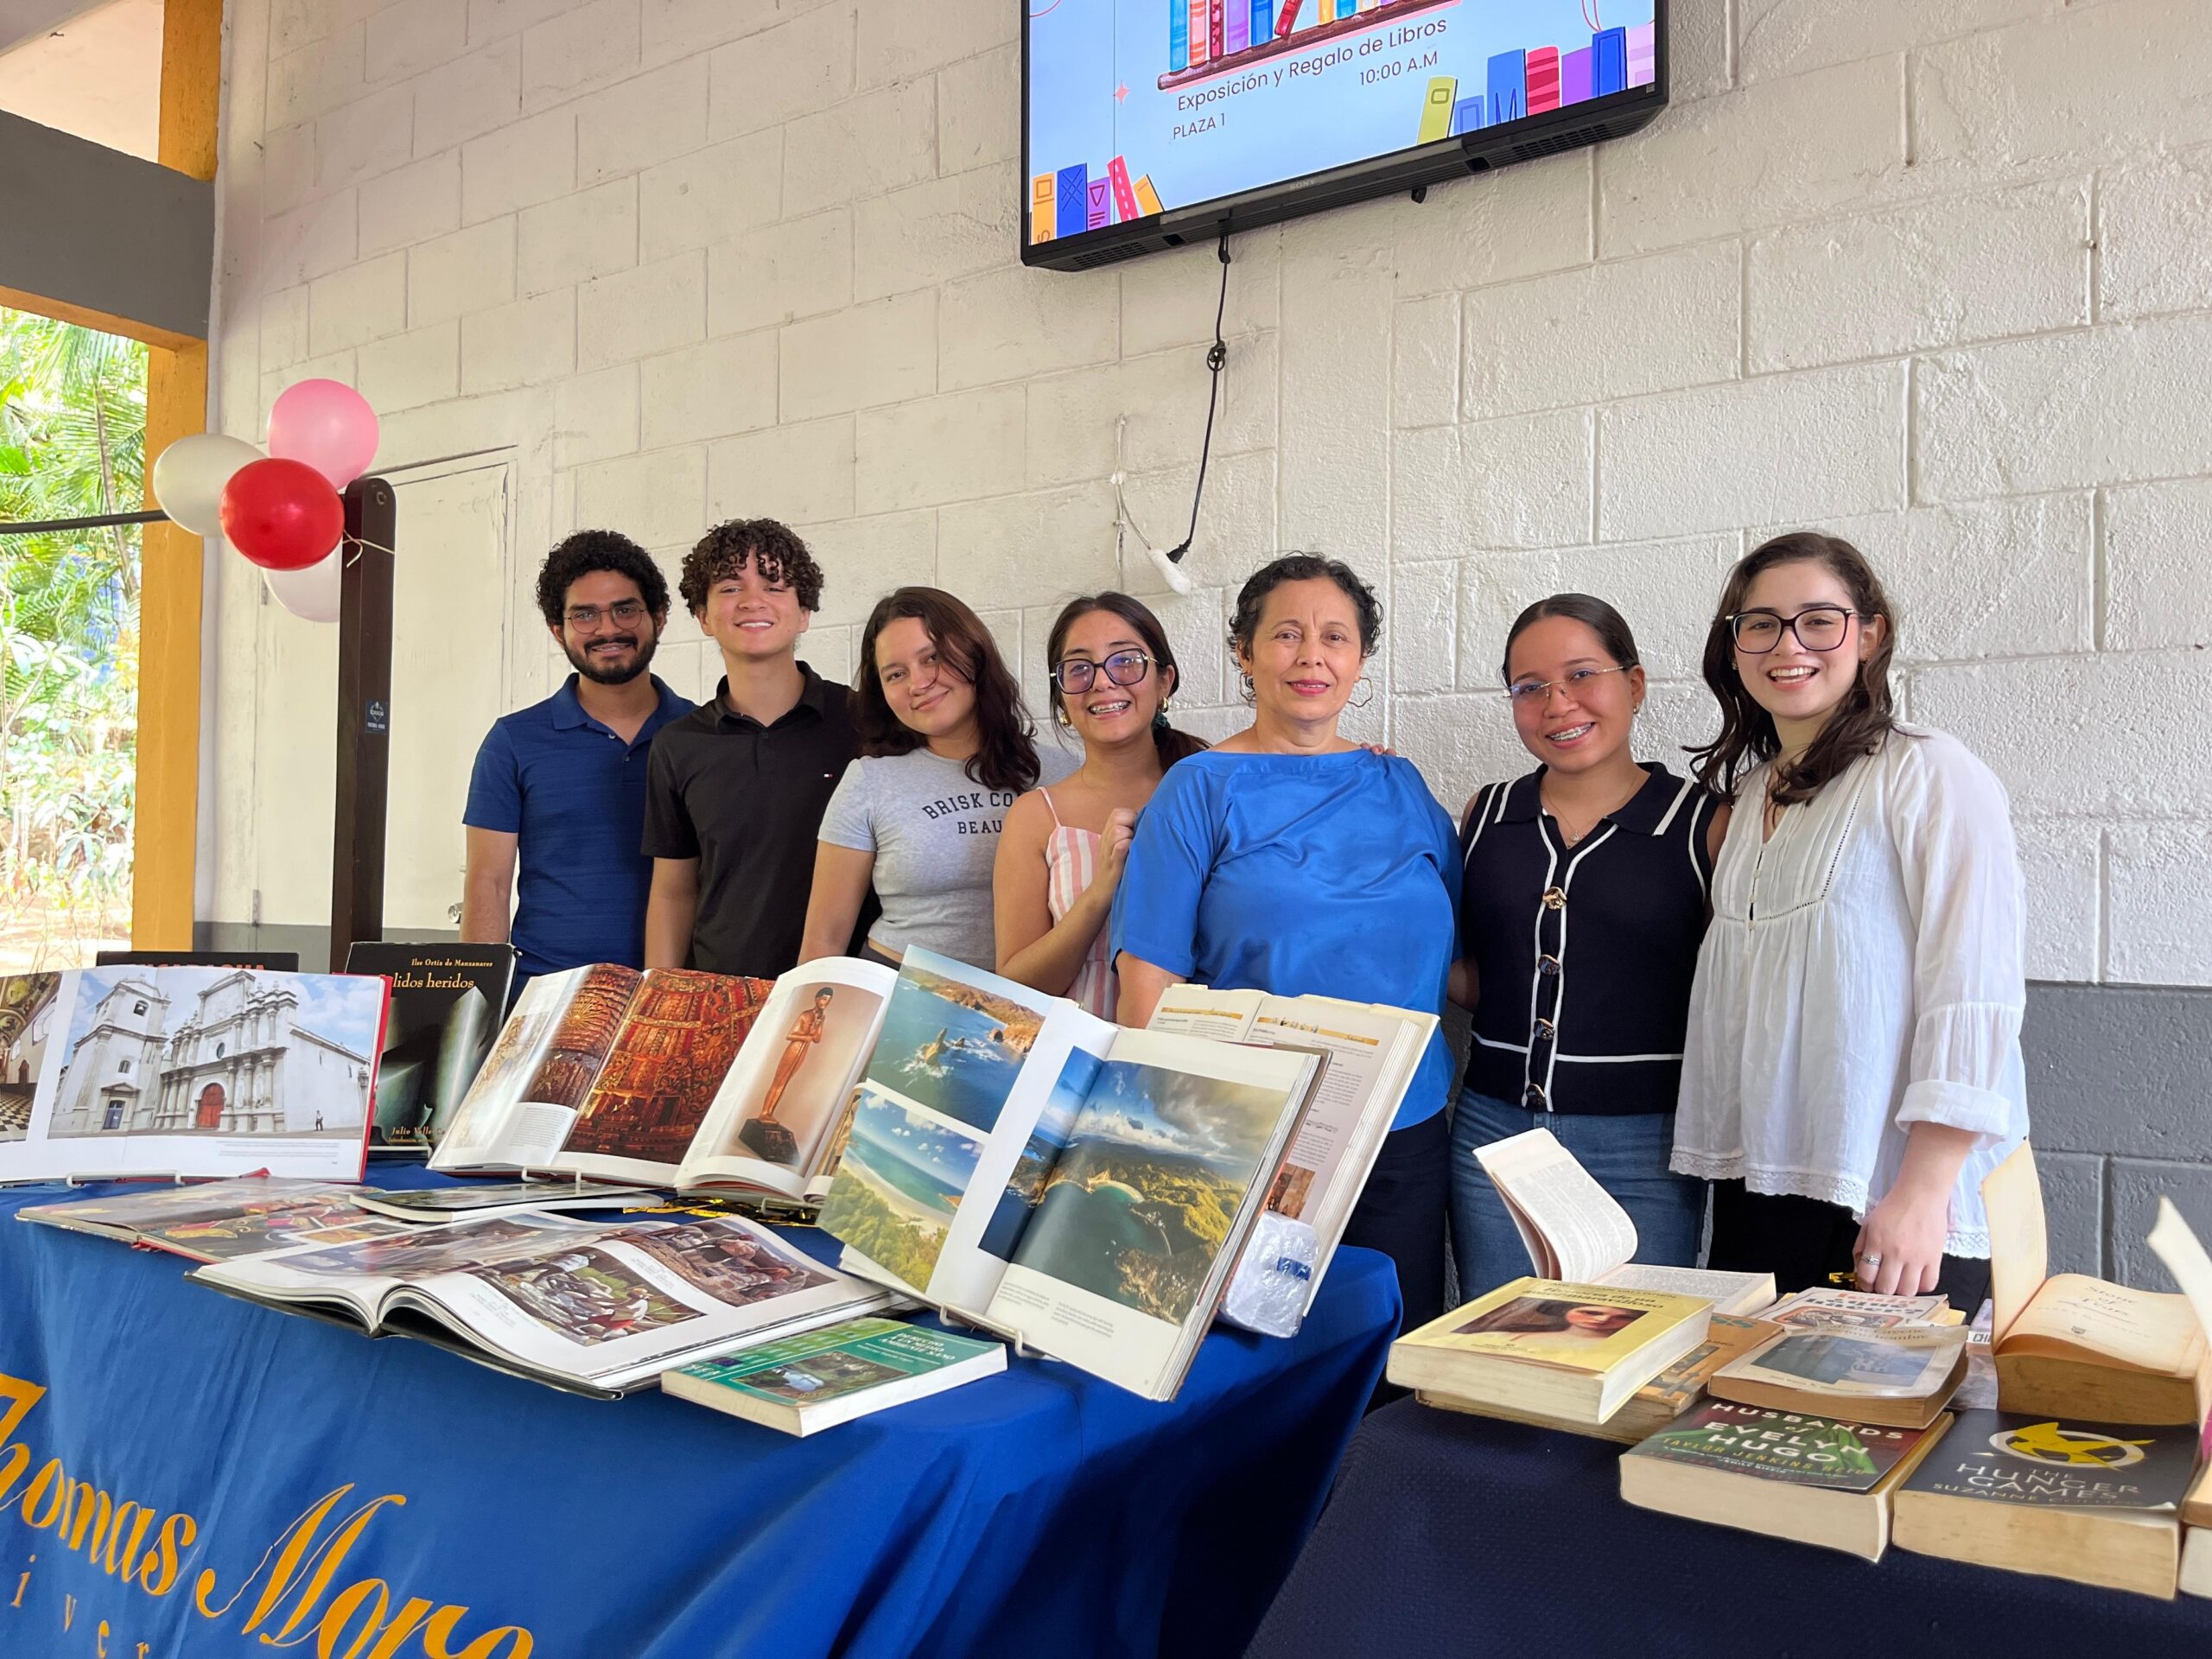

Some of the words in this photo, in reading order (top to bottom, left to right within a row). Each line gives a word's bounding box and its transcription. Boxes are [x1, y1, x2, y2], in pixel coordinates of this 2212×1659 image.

[1178, 73, 1268, 111] Exposición
[1274, 68, 1283, 86] y
[1289, 47, 1354, 78] Regalo
[1359, 37, 1382, 56] de
[1389, 18, 1447, 48] Libros
[1360, 60, 1402, 86] 10:00
[1407, 51, 1439, 72] A.M
[1173, 116, 1217, 139] PLAZA
[1221, 113, 1226, 126] 1
[1290, 179, 1316, 191] SONY
[922, 792, 984, 820] BRISK
[444, 958, 452, 967] de
[426, 972, 474, 988] heridos
[391, 1127, 410, 1136] Julio
[1567, 1293, 1664, 1309] maravilloso
[1712, 1403, 1904, 1440] HUSBANDS
[1784, 1426, 1814, 1434] of
[1662, 1438, 1726, 1453] TAYLOR
[1704, 1421, 1870, 1455] EVELYN
[1707, 1434, 1837, 1462] HUGO
[1732, 1451, 1814, 1470] JENKINS
[1956, 1463, 2141, 1494] HUNGER
[2031, 1469, 2075, 1478] THE
[1933, 1483, 2038, 1502] SUZANNE
[1967, 1476, 2118, 1499] GAMES
